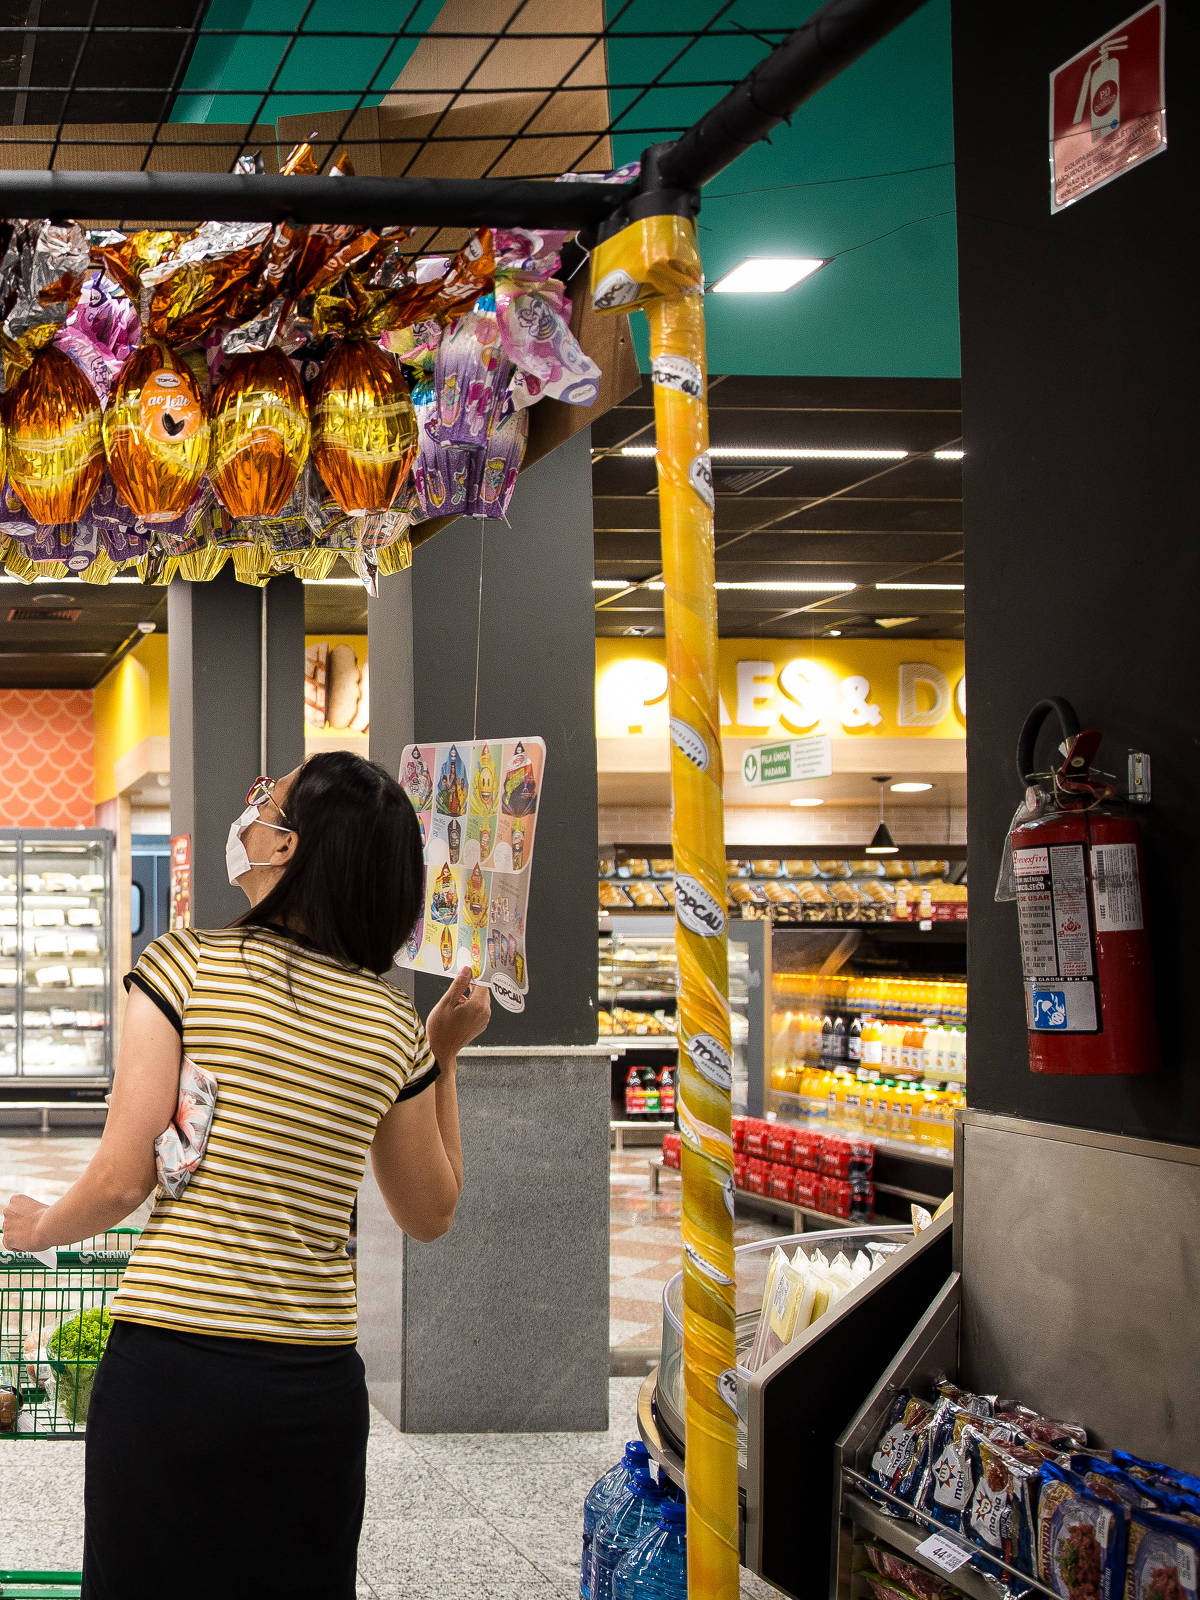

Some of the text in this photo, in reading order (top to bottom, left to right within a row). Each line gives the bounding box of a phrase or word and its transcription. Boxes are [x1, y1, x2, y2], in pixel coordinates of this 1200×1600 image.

[148, 393, 191, 410] ao Leite
[693, 1040, 731, 1077] TOPC
